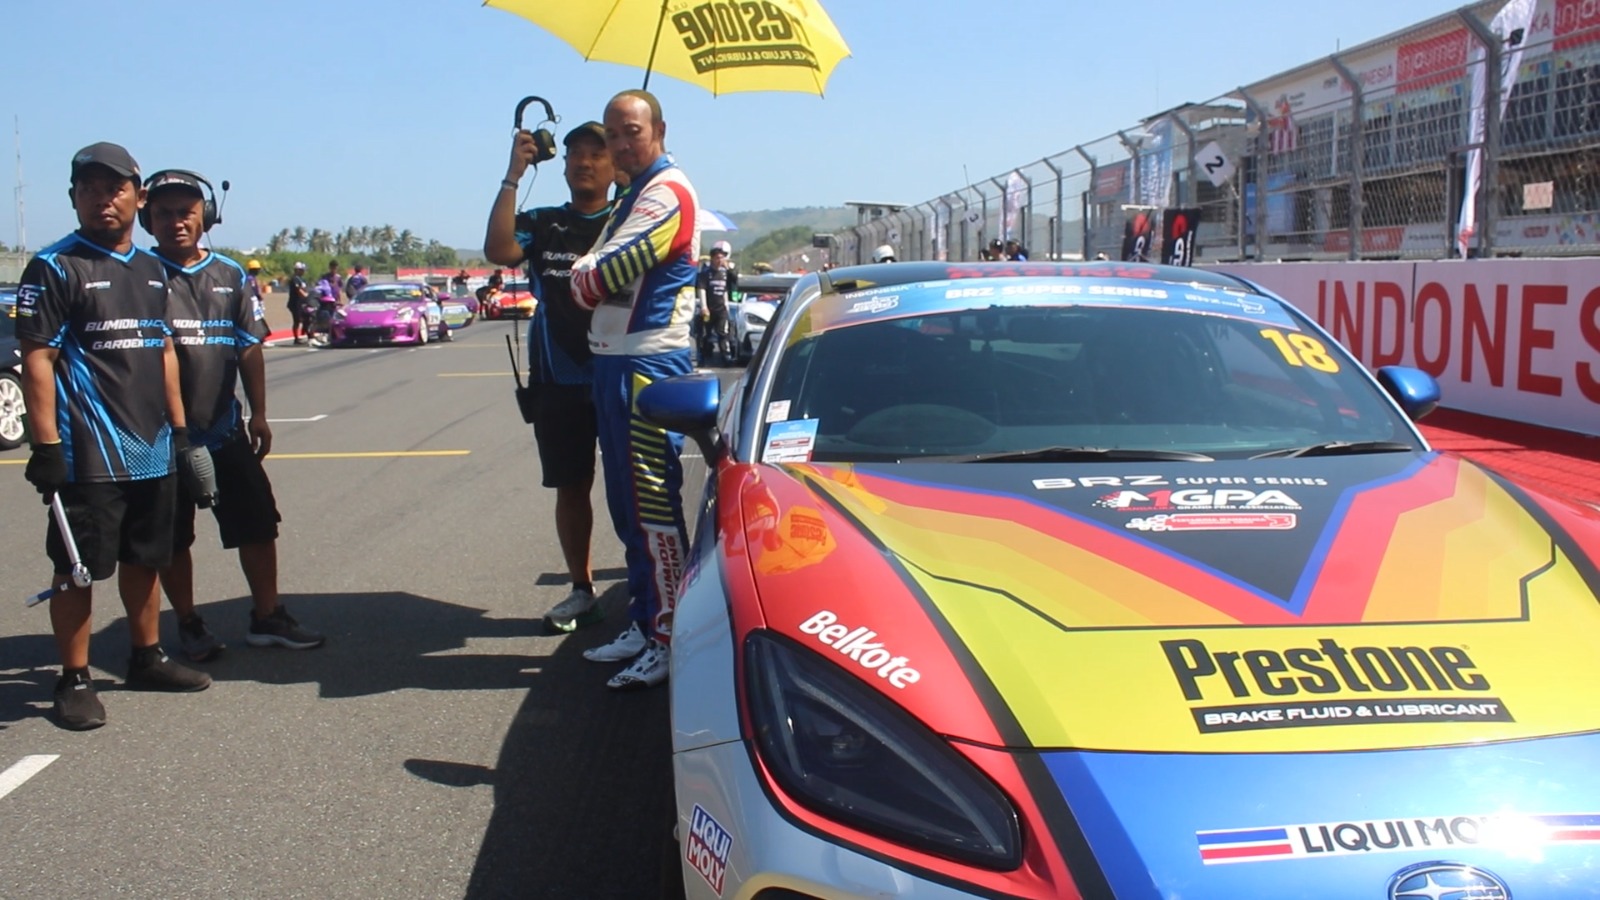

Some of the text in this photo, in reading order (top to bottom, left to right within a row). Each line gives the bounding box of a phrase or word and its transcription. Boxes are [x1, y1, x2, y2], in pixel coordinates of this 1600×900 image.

[1205, 155, 1224, 174] 2
[945, 285, 1168, 299] BRZ SUPER SERIES
[1259, 328, 1340, 374] 18
[1032, 475, 1328, 490] BRZ SUPER SERIES
[1159, 638, 1491, 701] Prestone
[1204, 703, 1498, 726] BRAKE FLUID & LUBRICANT
[692, 808, 730, 864] LIQUI
[1298, 820, 1414, 853] LIQUI
[688, 836, 725, 890] MOLY
